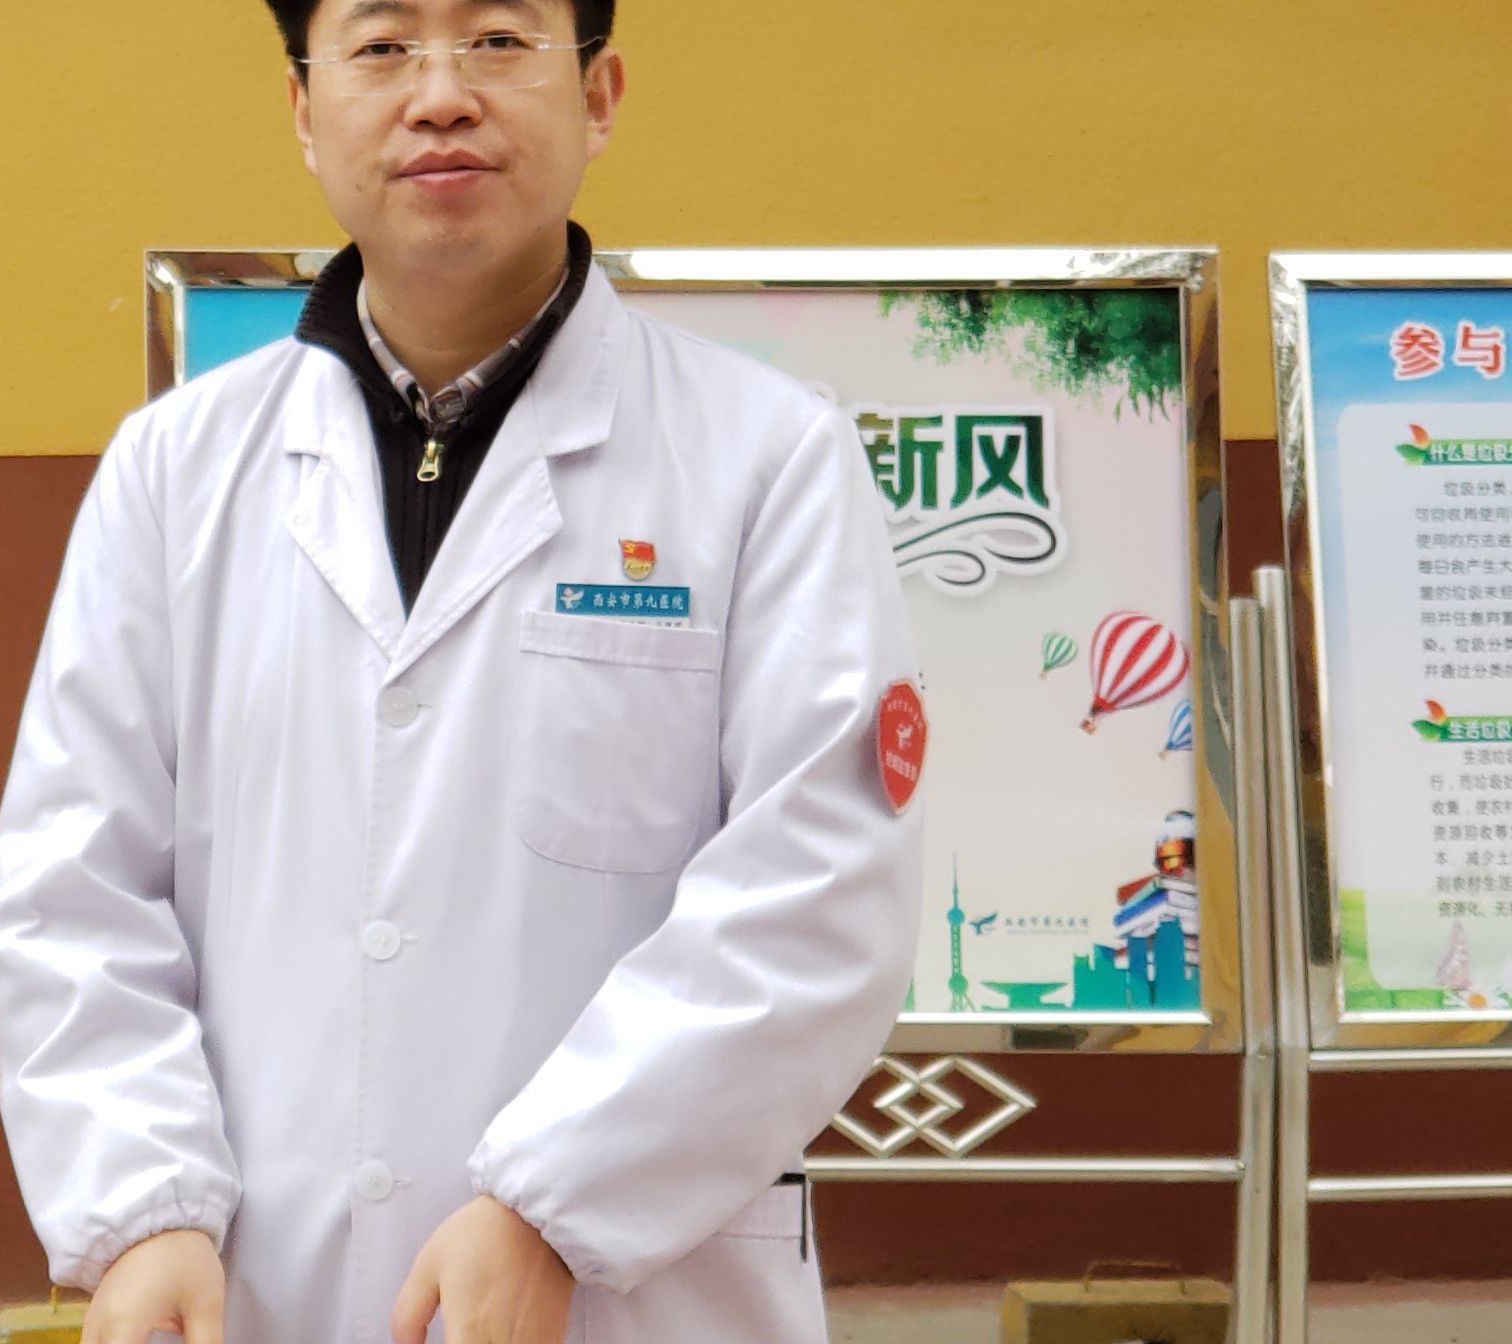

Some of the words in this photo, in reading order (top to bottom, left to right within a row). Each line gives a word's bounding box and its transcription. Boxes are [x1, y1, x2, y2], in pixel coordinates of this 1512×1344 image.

[1391, 323, 1504, 379] 参与
[856, 412, 1050, 511] 新风
[1430, 443, 1512, 462] 什么是垃圾
